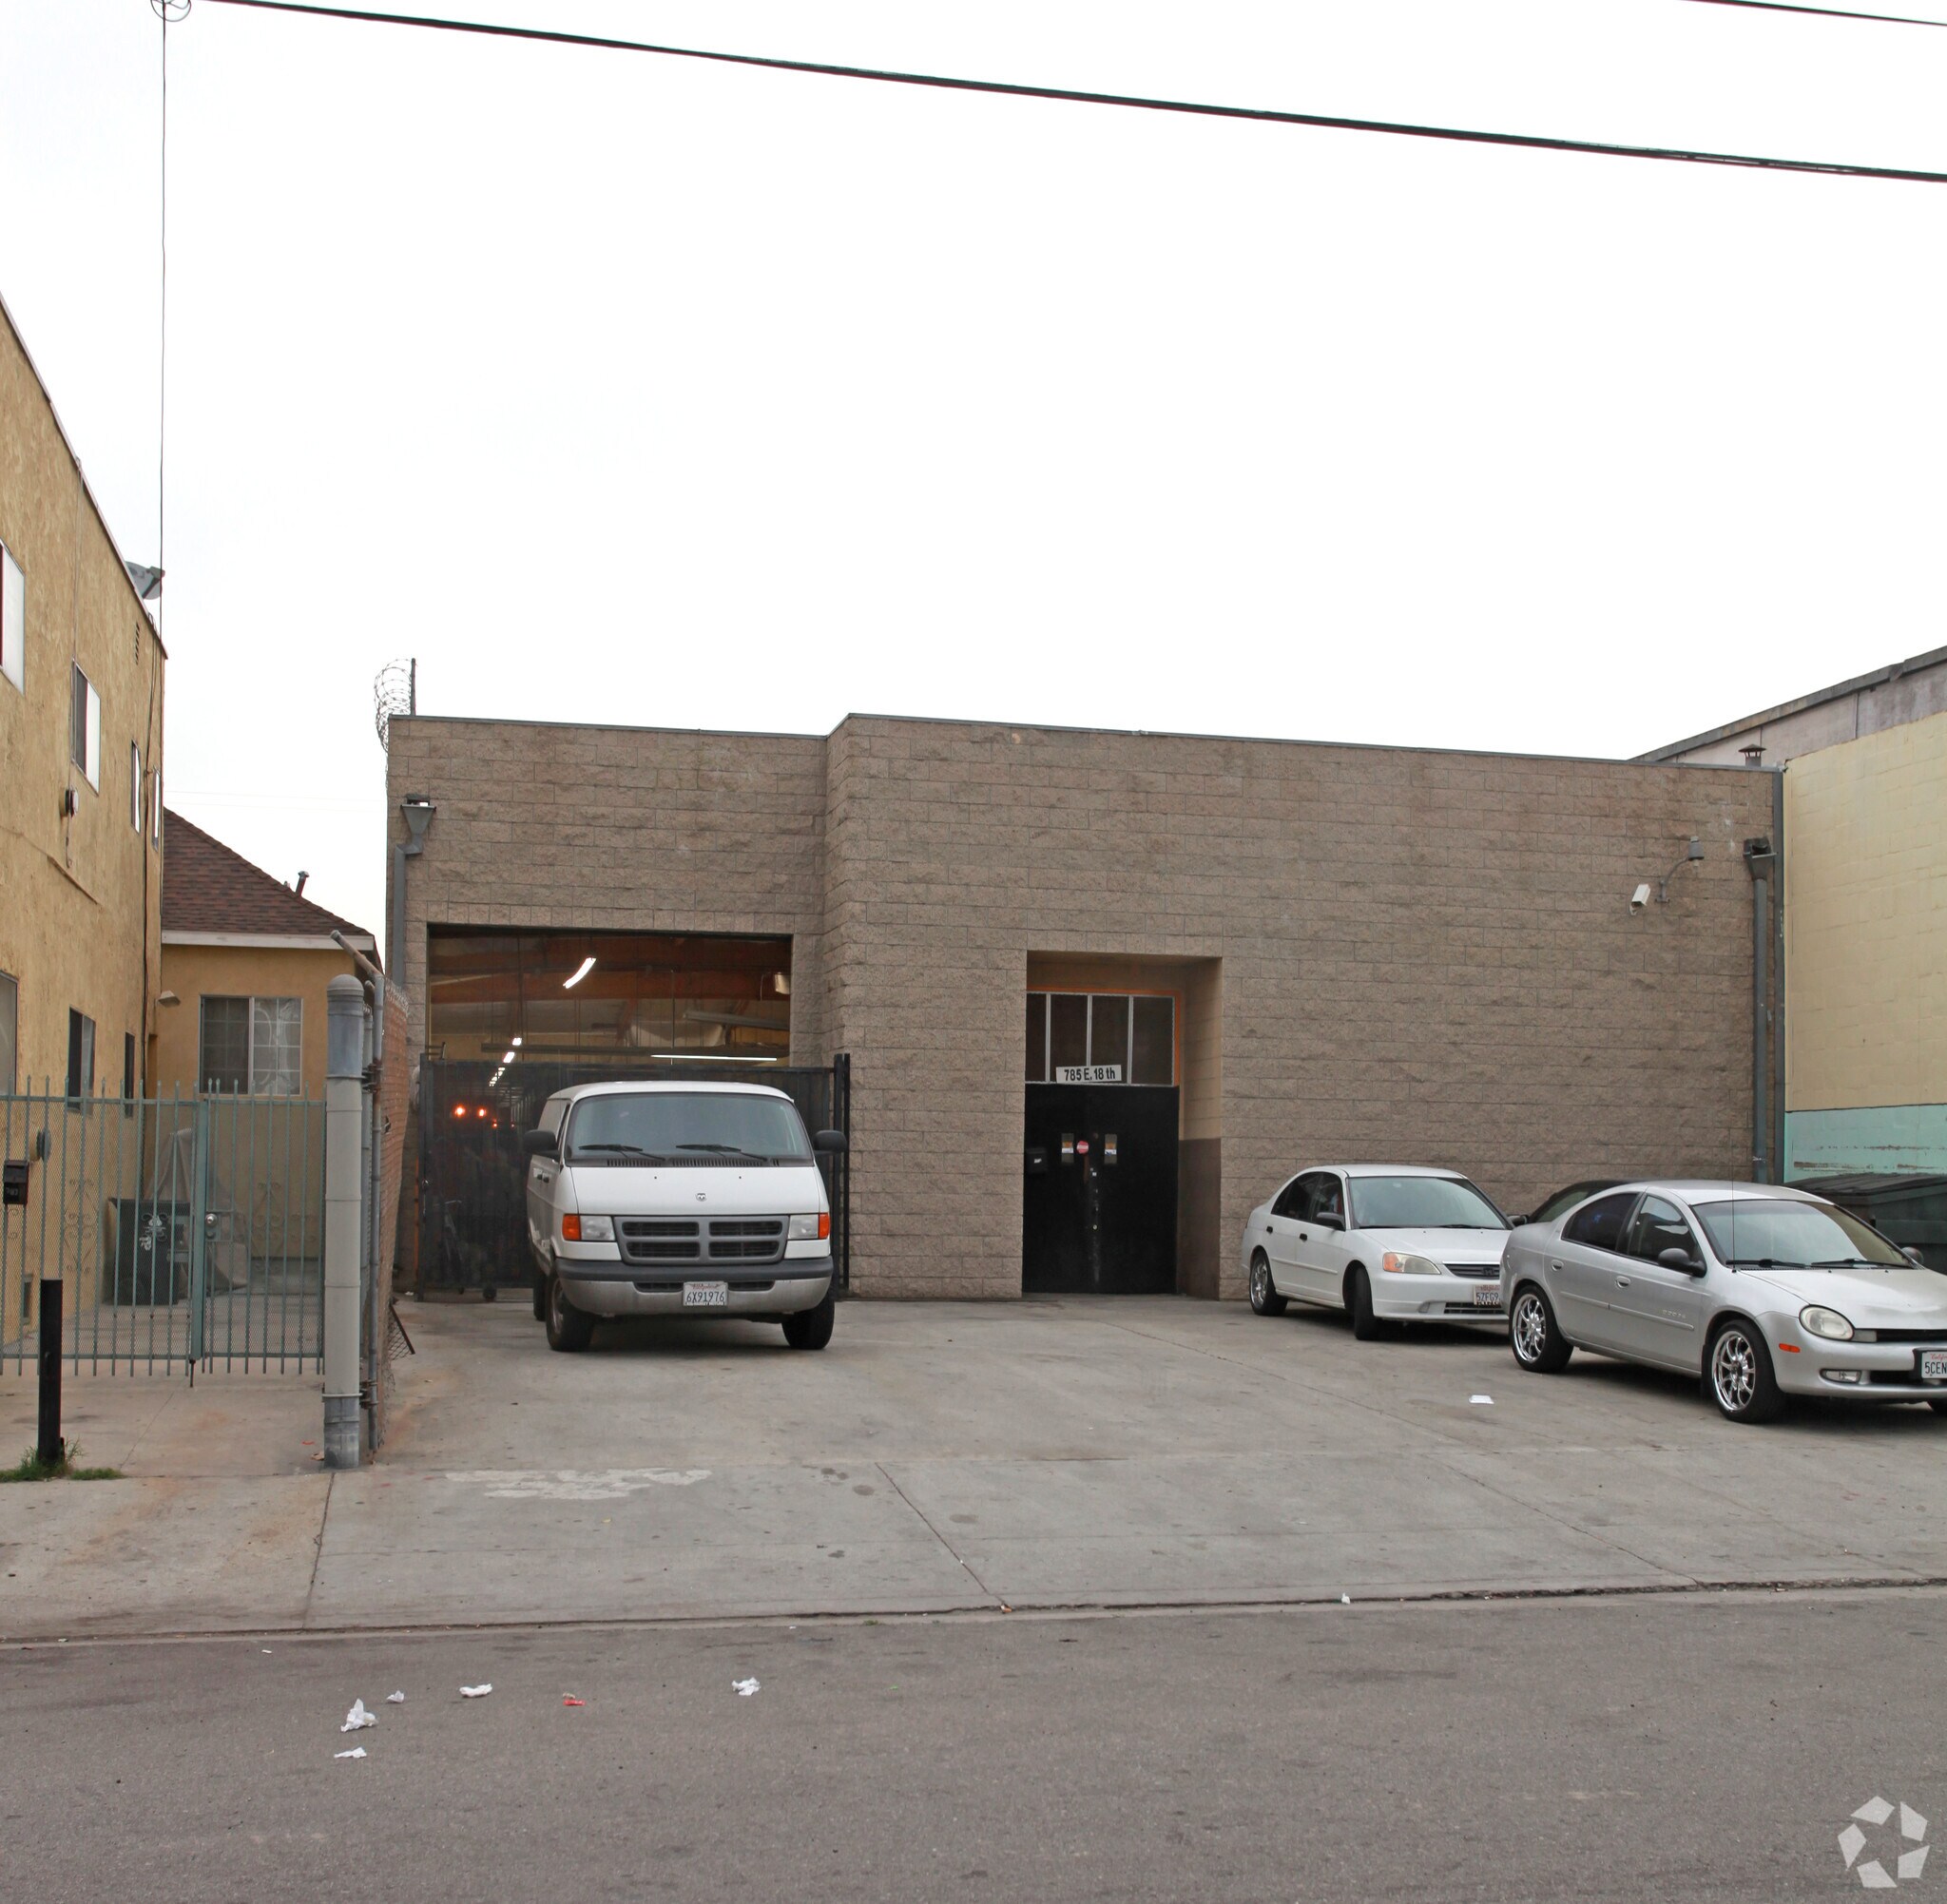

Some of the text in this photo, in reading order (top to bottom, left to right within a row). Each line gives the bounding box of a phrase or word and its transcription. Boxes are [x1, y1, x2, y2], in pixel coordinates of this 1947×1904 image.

[1064, 1068, 1082, 1082] 785
[1084, 1067, 1092, 1081] E.
[686, 1291, 725, 1303] 6X91976
[1475, 1292, 1501, 1302] 5ZFG9
